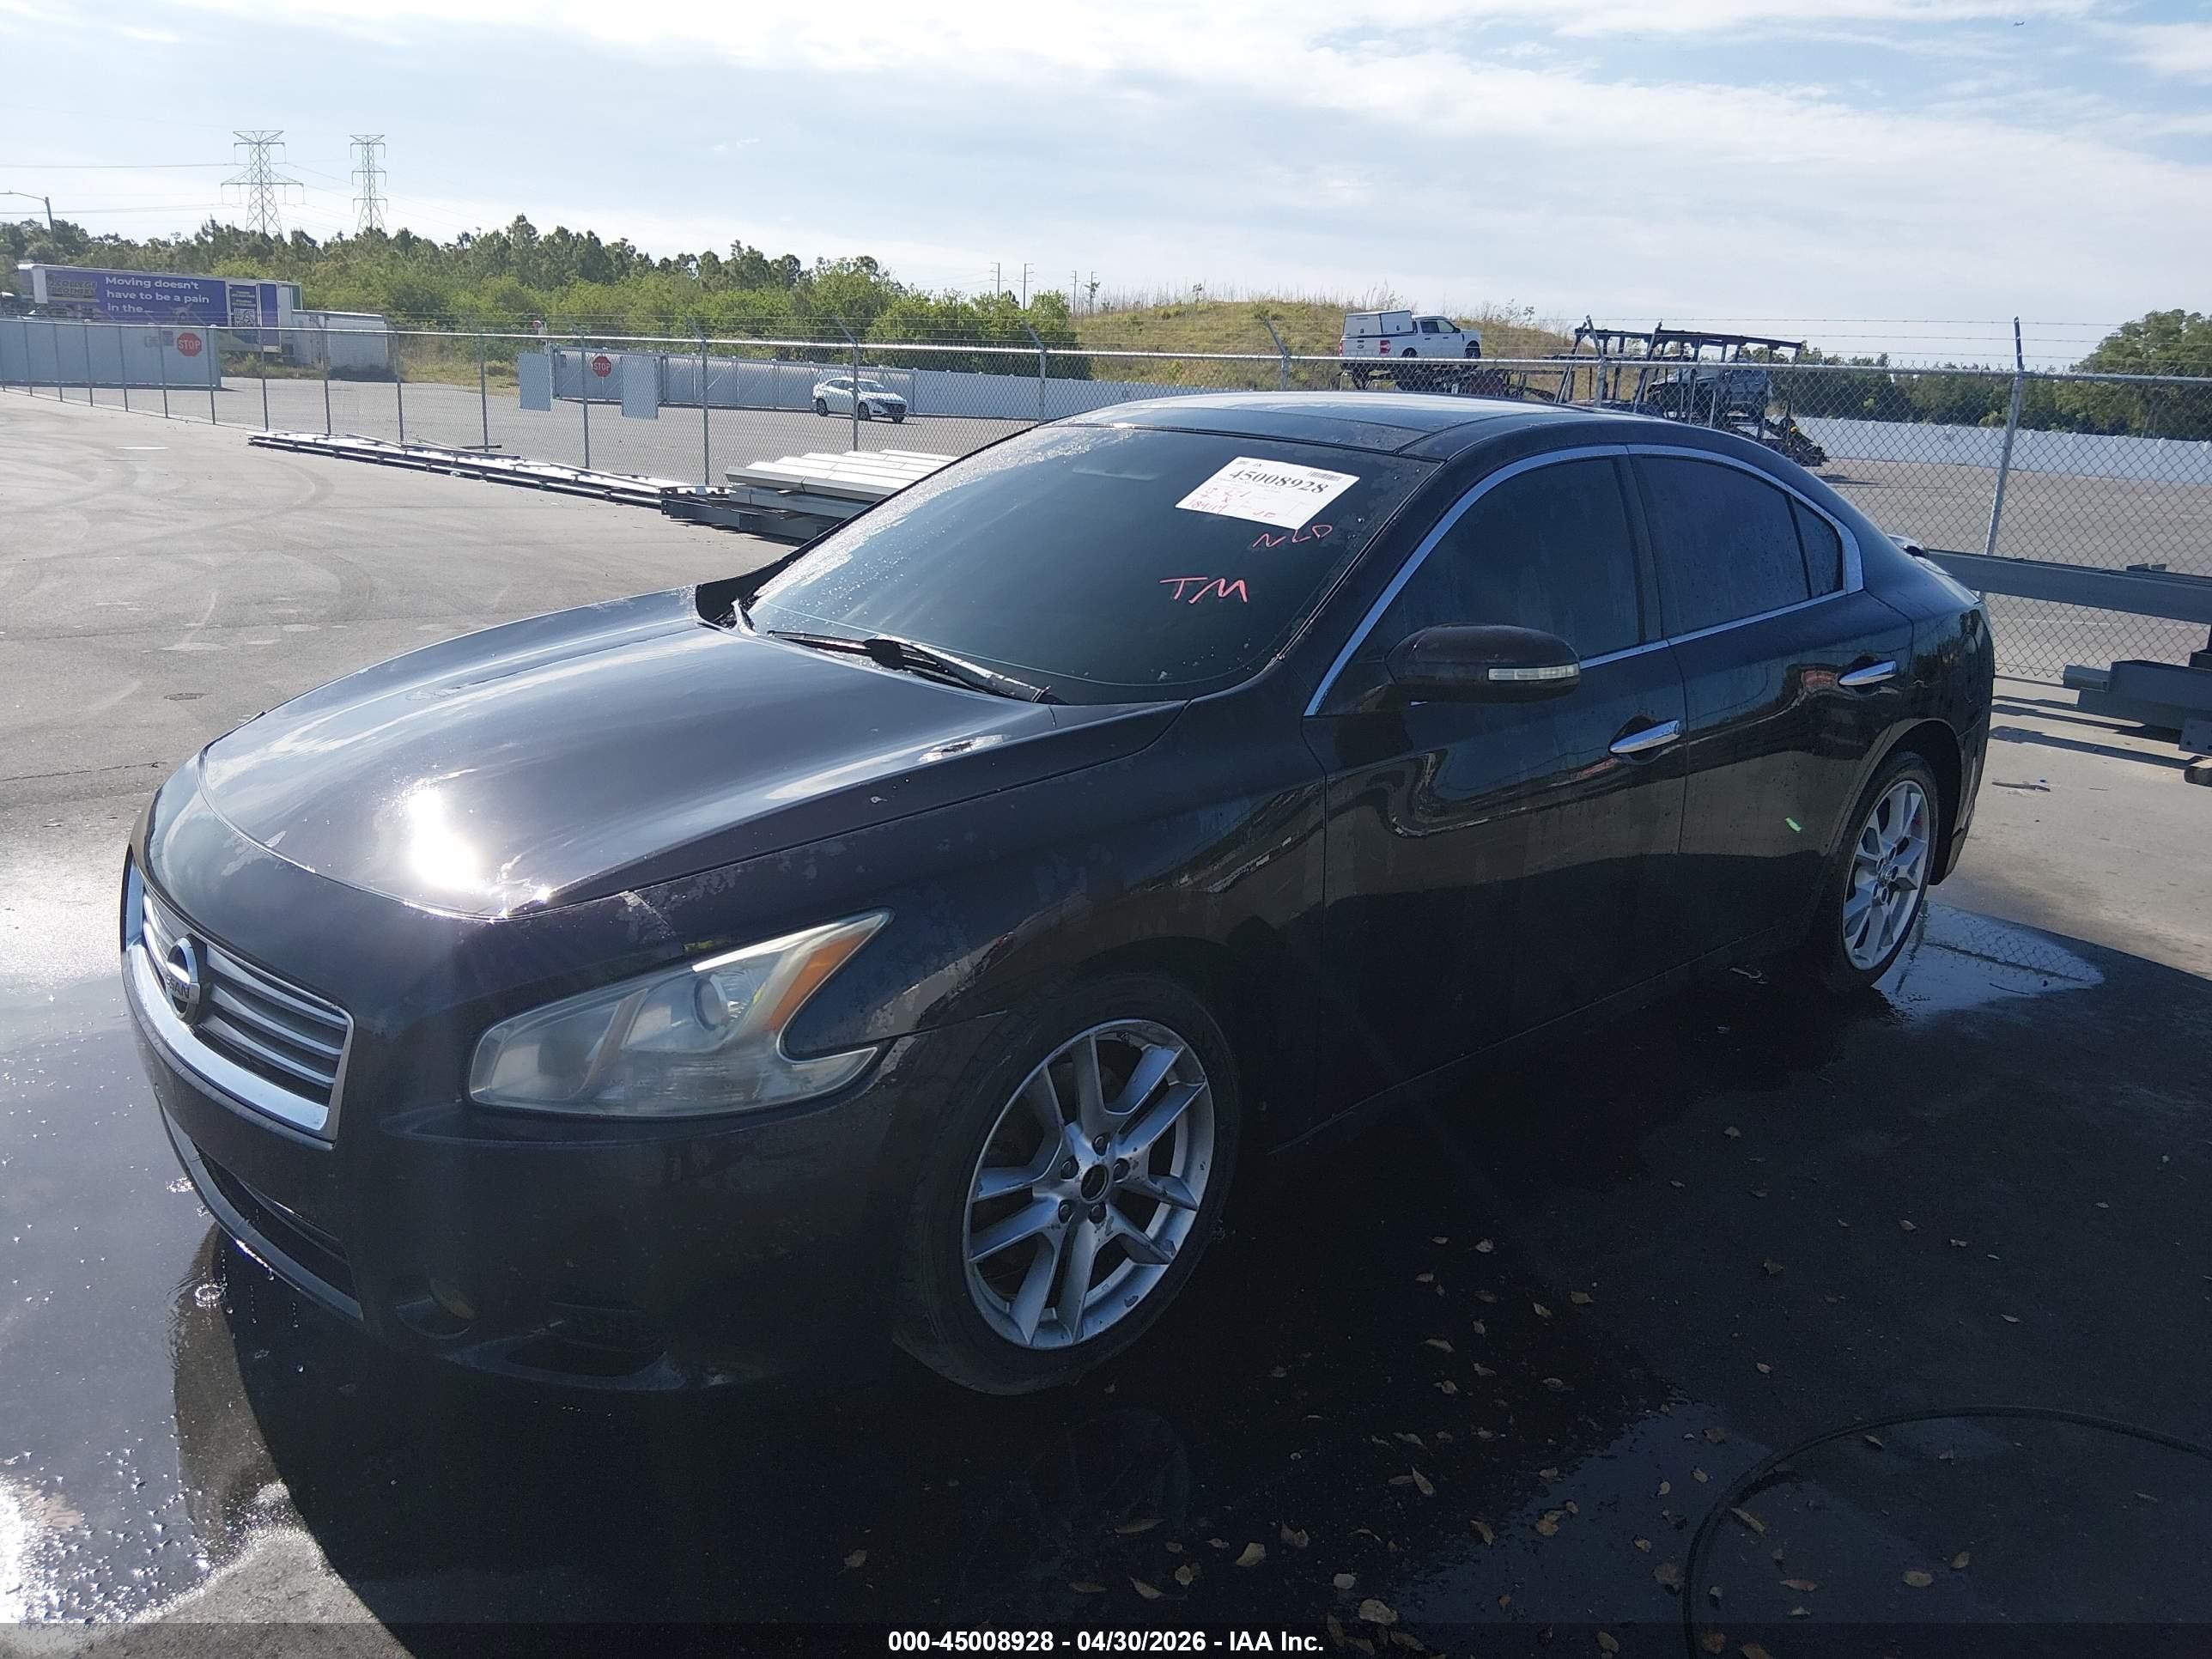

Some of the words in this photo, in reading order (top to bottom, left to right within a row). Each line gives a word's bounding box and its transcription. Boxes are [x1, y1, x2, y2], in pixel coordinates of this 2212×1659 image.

[105, 276, 152, 289] Moving
[154, 280, 199, 290] doesn't
[106, 289, 137, 300] have
[139, 290, 153, 301] to
[155, 291, 172, 301] be
[184, 295, 210, 304] pain
[107, 303, 120, 313] in
[178, 339, 201, 351] STOP
[593, 362, 611, 372] STOP
[1230, 469, 1329, 494] 45008928
[1159, 576, 1248, 605] TM
